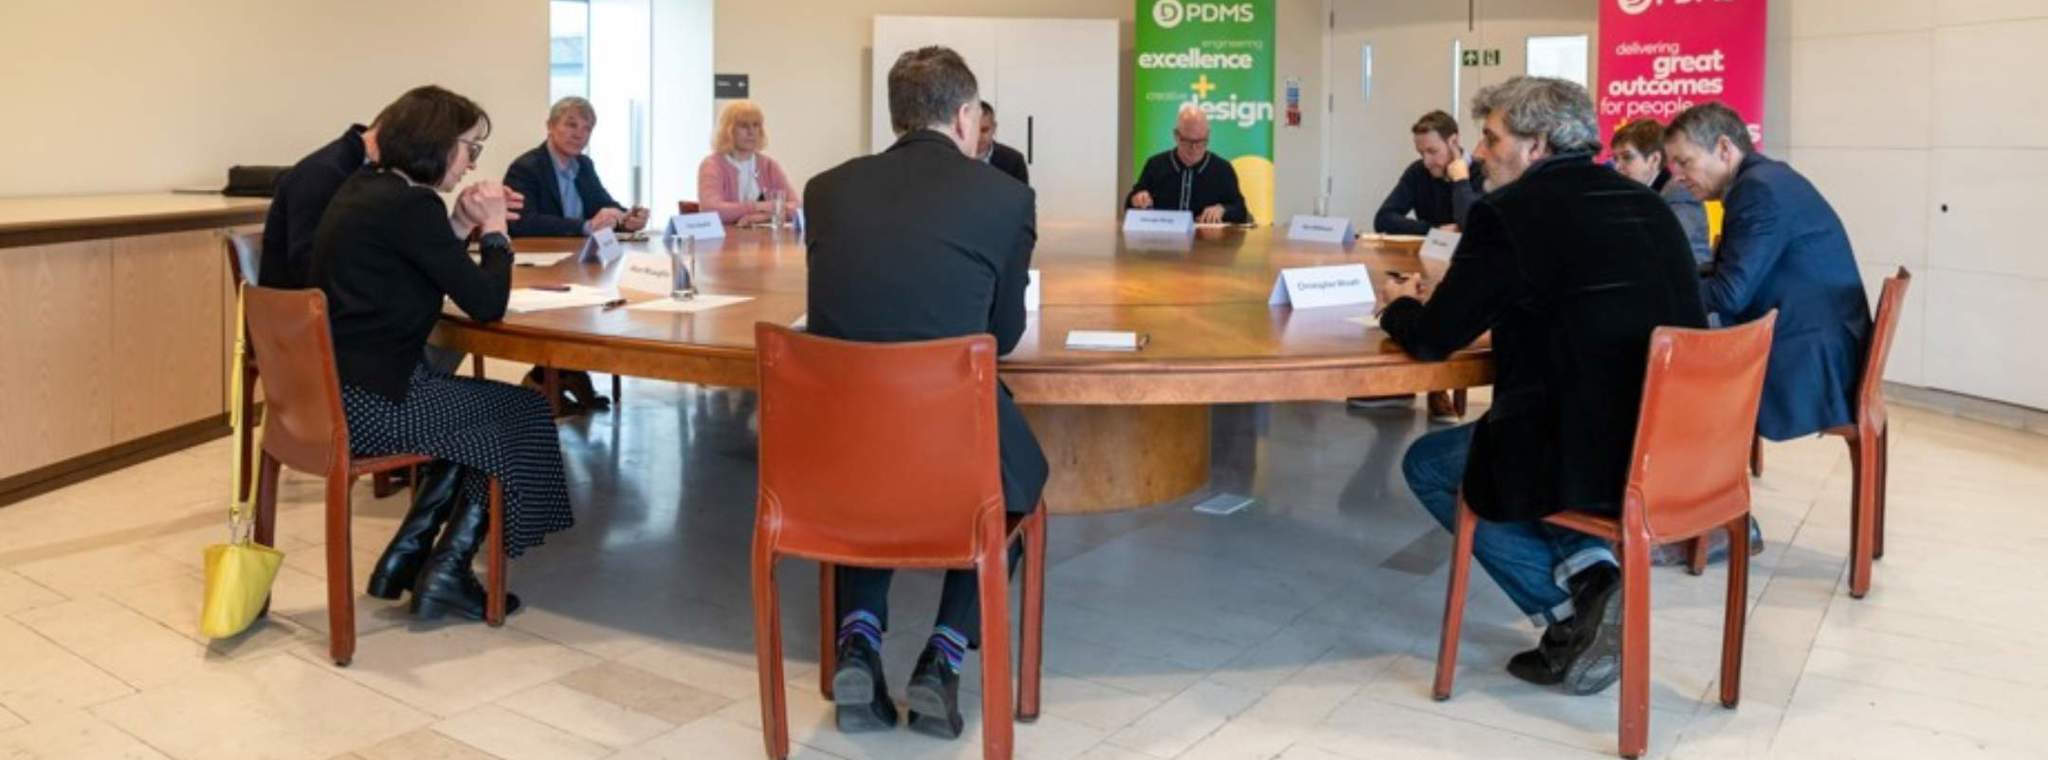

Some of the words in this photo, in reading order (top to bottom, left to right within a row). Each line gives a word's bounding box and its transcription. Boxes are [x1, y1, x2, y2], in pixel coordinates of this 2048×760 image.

[1186, 4, 1254, 22] PDMS
[1201, 38, 1263, 50] engineering
[1615, 40, 1680, 56] delivering
[1138, 48, 1252, 69] excellence
[1653, 49, 1724, 79] great
[1609, 76, 1723, 96] outcomes
[1179, 93, 1274, 127] design
[1601, 97, 1625, 115] for
